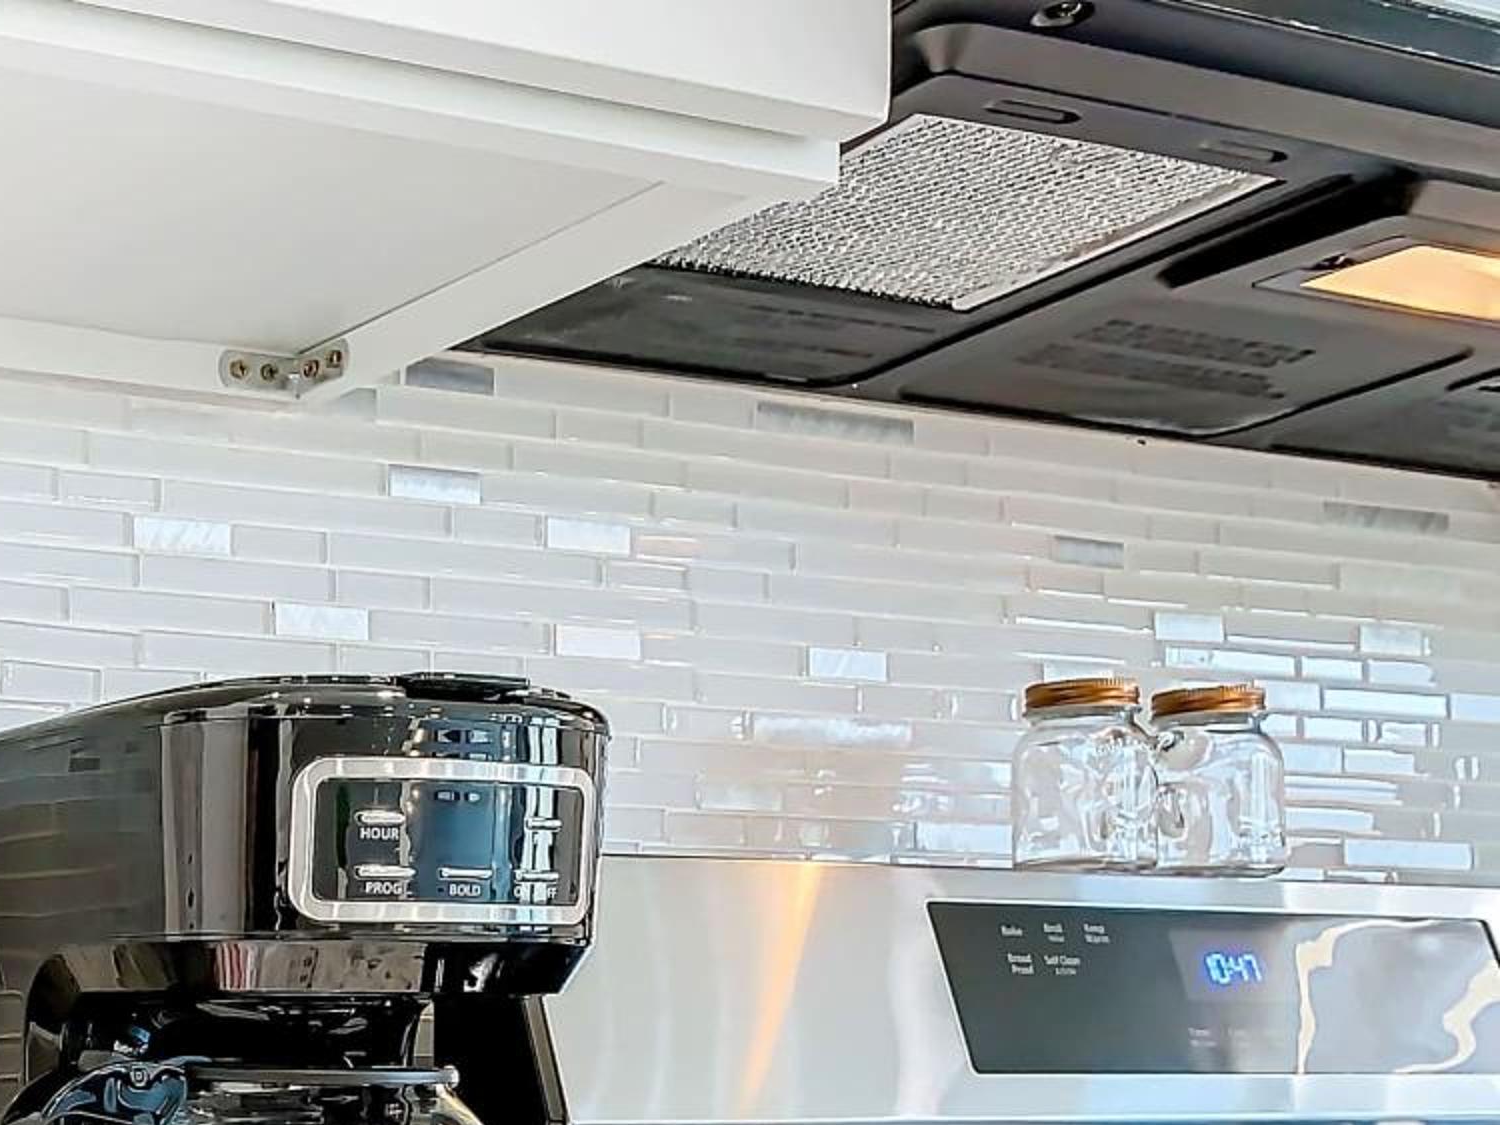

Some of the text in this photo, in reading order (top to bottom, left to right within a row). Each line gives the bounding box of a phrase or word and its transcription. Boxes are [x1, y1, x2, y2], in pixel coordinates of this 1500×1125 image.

[359, 826, 400, 841] HOUR
[365, 880, 403, 895] PROG
[448, 882, 482, 897] BOLD
[1205, 952, 1262, 985] 10:47
